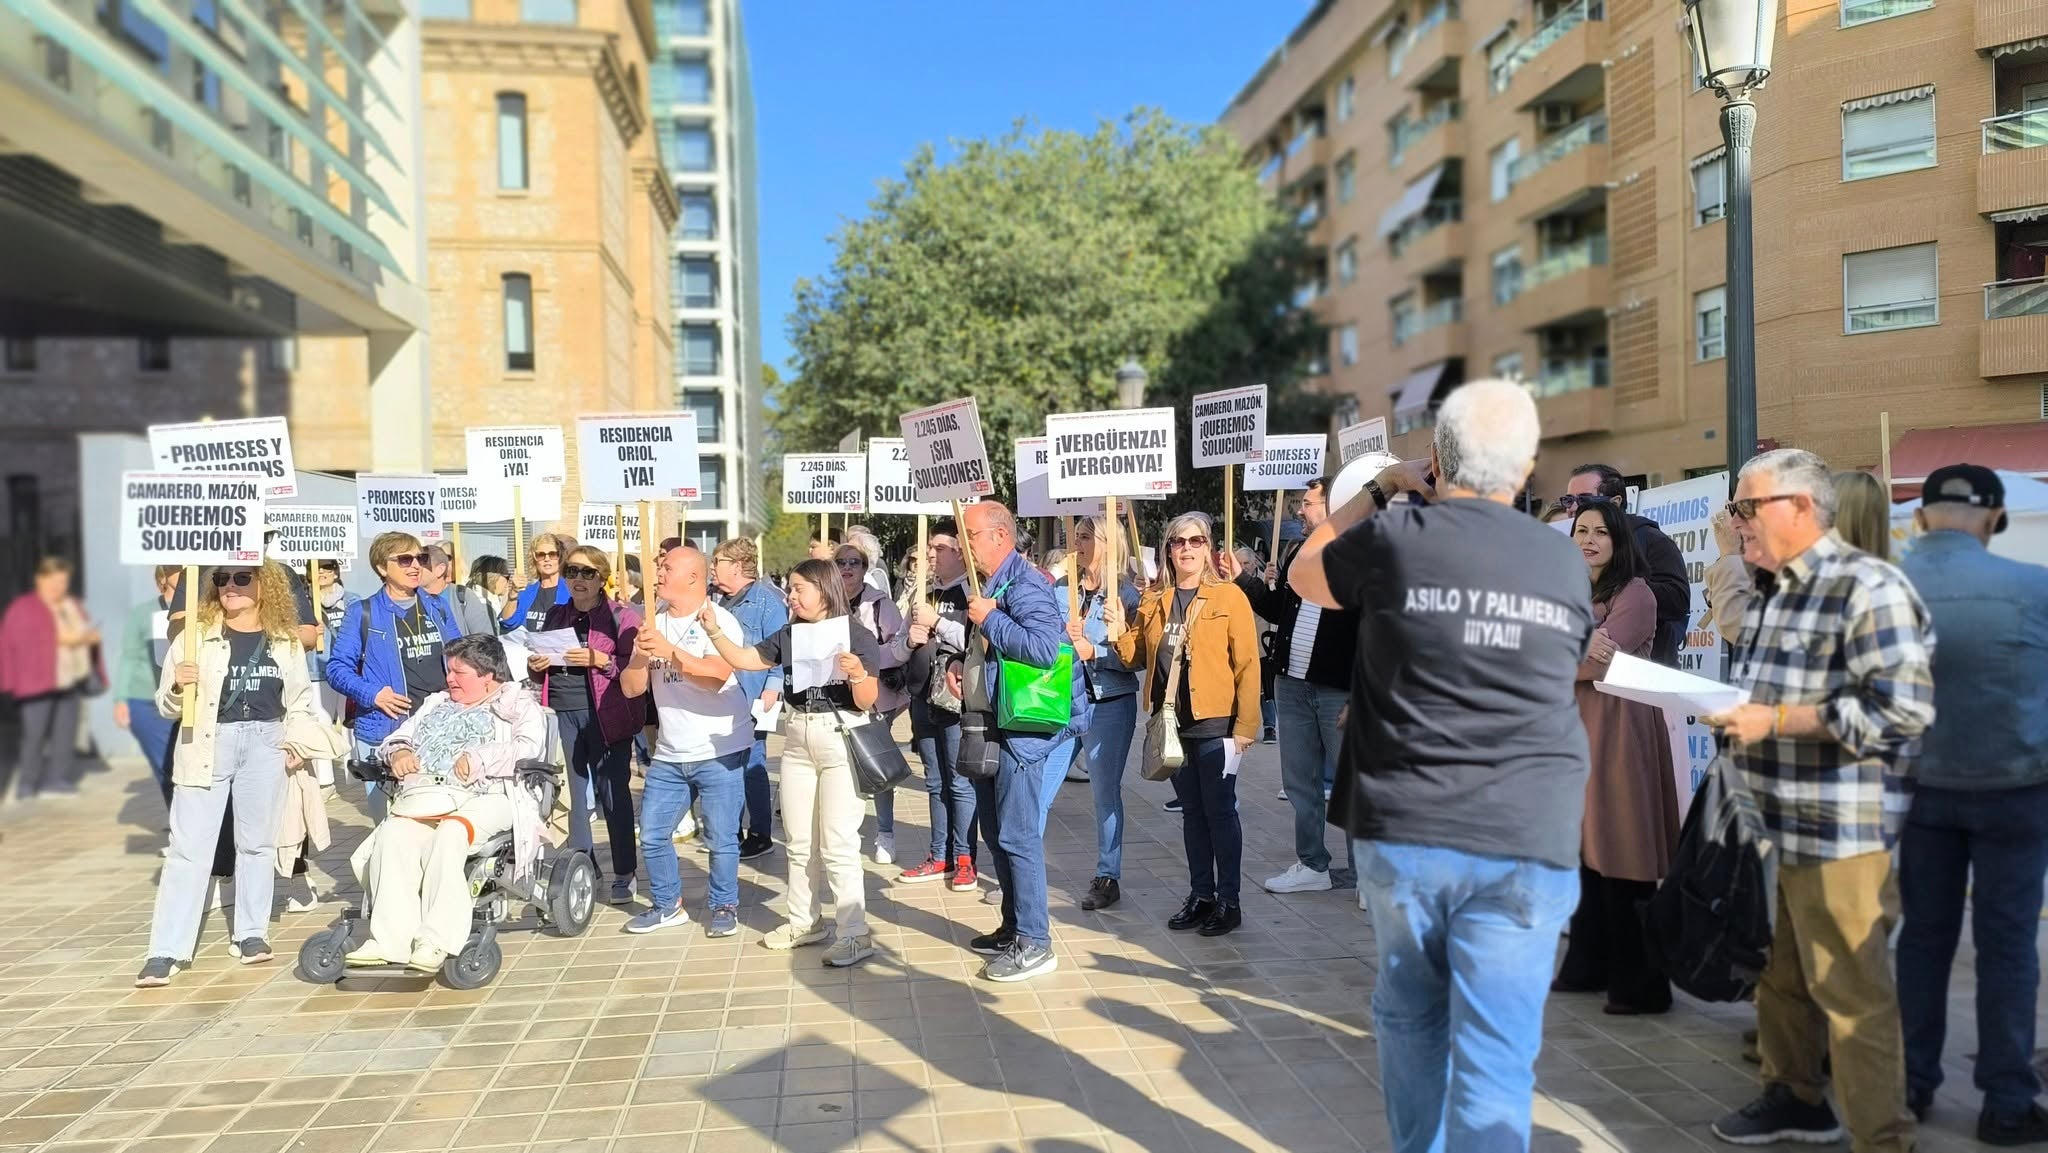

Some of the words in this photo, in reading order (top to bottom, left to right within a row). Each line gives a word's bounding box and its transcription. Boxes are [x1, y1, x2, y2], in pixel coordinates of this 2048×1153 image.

[1195, 399, 1234, 418] CAMARERO,
[1234, 393, 1262, 410] MAZÓN,
[914, 419, 937, 438] 2.245
[936, 412, 960, 433] DÍAS,
[1200, 414, 1255, 440] ¡QUEREMOS
[485, 435, 544, 448] RESIDENCIA
[600, 426, 673, 443] RESIDENCIA
[1055, 428, 1167, 456] ¡VERGÜENZA!
[171, 438, 268, 464] PROMESES
[271, 438, 282, 456] Y
[618, 445, 657, 462] ORIOL,
[929, 438, 953, 464] ¡SIN
[1202, 433, 1253, 457] SOLUCIÓN!
[499, 448, 531, 460] ORIOL,
[1265, 448, 1311, 461] ROMESES
[1313, 447, 1320, 460] Y
[503, 462, 529, 478] ¡YA!
[801, 461, 824, 472] 2.245
[826, 459, 848, 472] DÍAS,
[1060, 453, 1163, 479] ¡VERGONYA!
[1258, 462, 1317, 476] SOLUCIONS
[624, 466, 655, 489] ¡YA!
[812, 475, 835, 490] ¡SIN
[915, 459, 985, 490] SOLUCIONES!
[127, 482, 205, 501] CAMARERO,
[208, 481, 260, 501] MAZÓN,
[368, 490, 425, 505] PROMESES
[427, 491, 435, 506] Y
[787, 490, 861, 504] SOLUCIONES!
[138, 505, 247, 528] ¡QUEREMOS
[269, 512, 320, 523] CAMARERO,
[373, 507, 435, 523] SOLUCIONS
[142, 527, 242, 551] SOLUCIÓN!
[280, 539, 344, 552] SOLUCIÓN!
[1699, 528, 1708, 551] Y
[1405, 587, 1461, 612] ASILO
[1467, 589, 1481, 614] Y
[1485, 591, 1572, 632] PALMERAL
[404, 636, 410, 646] Y
[1696, 653, 1703, 669] Y
[231, 665, 239, 677] Y
